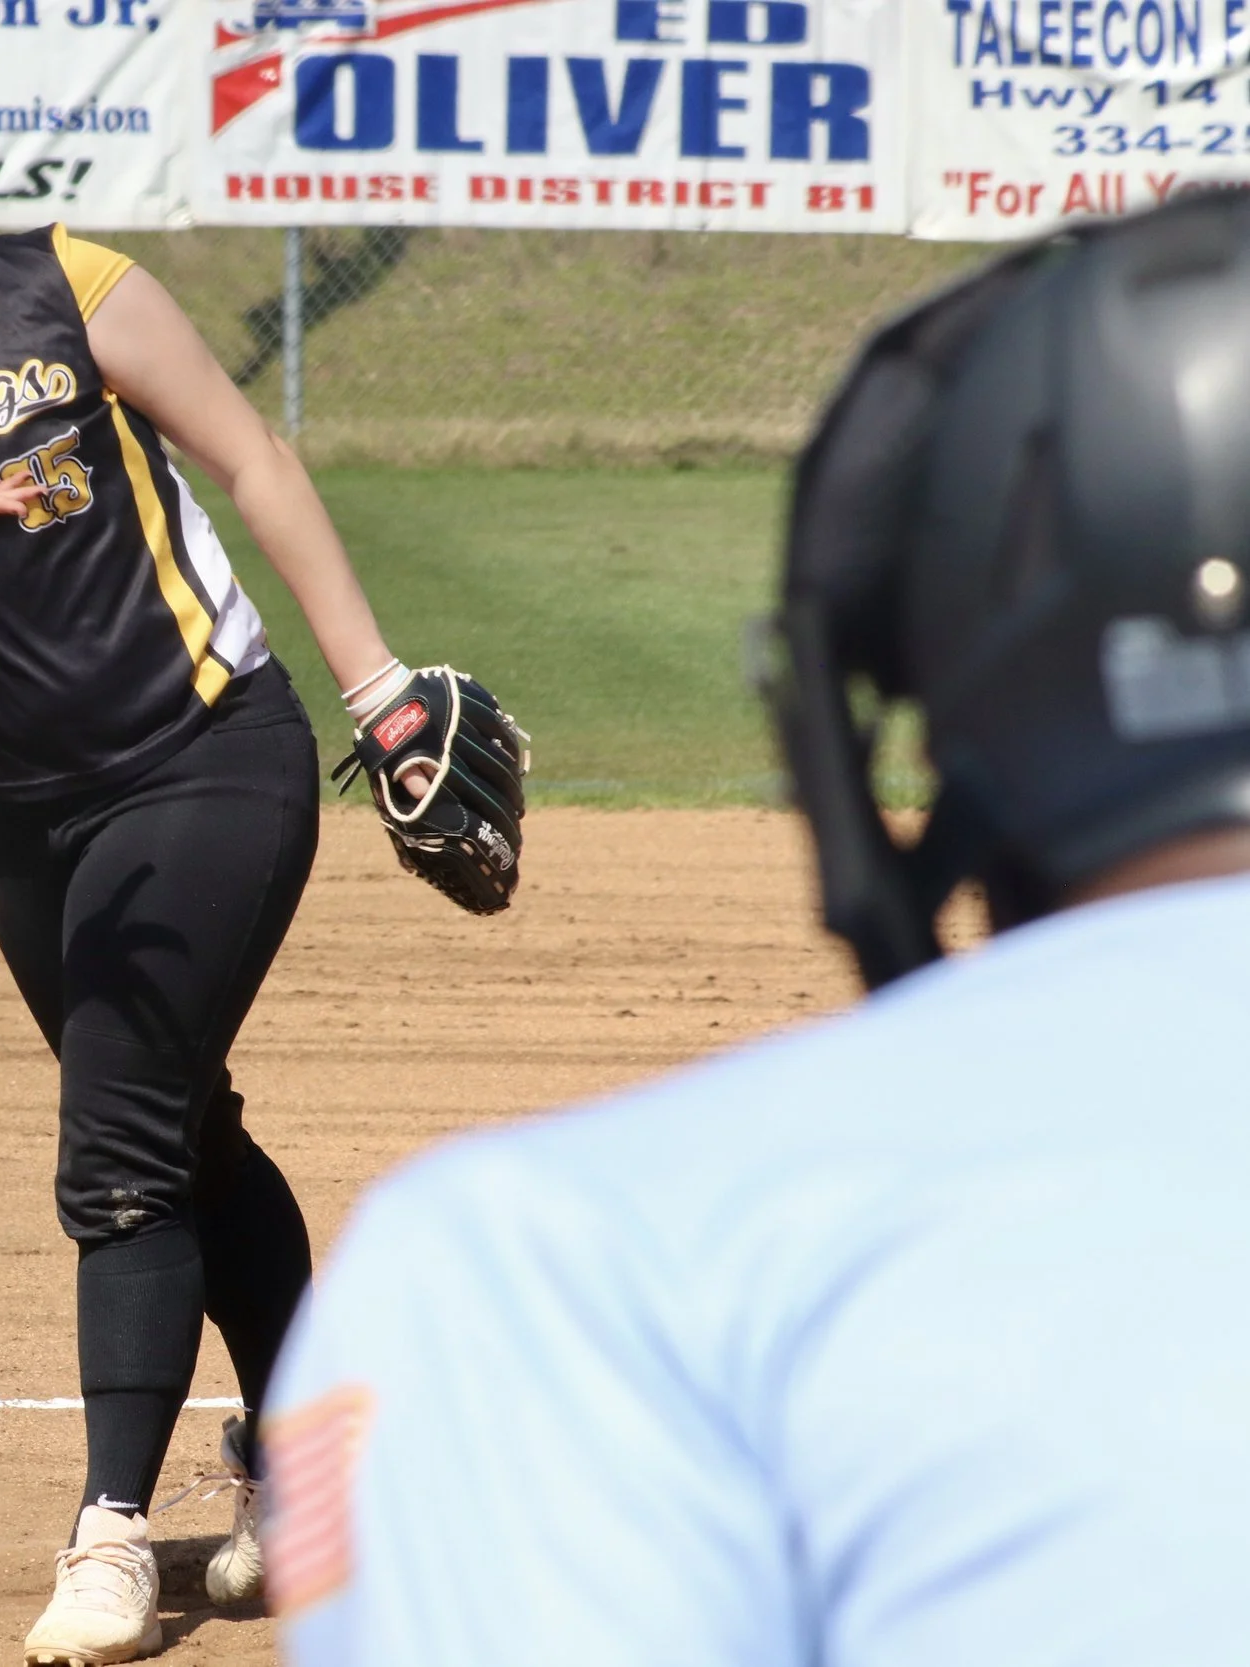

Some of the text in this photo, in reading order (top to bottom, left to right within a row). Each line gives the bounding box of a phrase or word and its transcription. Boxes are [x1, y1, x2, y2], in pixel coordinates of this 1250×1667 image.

[617, 0, 808, 44] ED
[945, 0, 1200, 67] TALEECON
[294, 54, 870, 160] OLIVER
[970, 79, 1114, 117] Hwy
[1141, 77, 1217, 106] 14
[1052, 124, 1250, 156] 334-2
[227, 174, 874, 212] HOUSE DISTRICT 81
[943, 171, 1046, 217] "For
[1060, 172, 1127, 215] All
